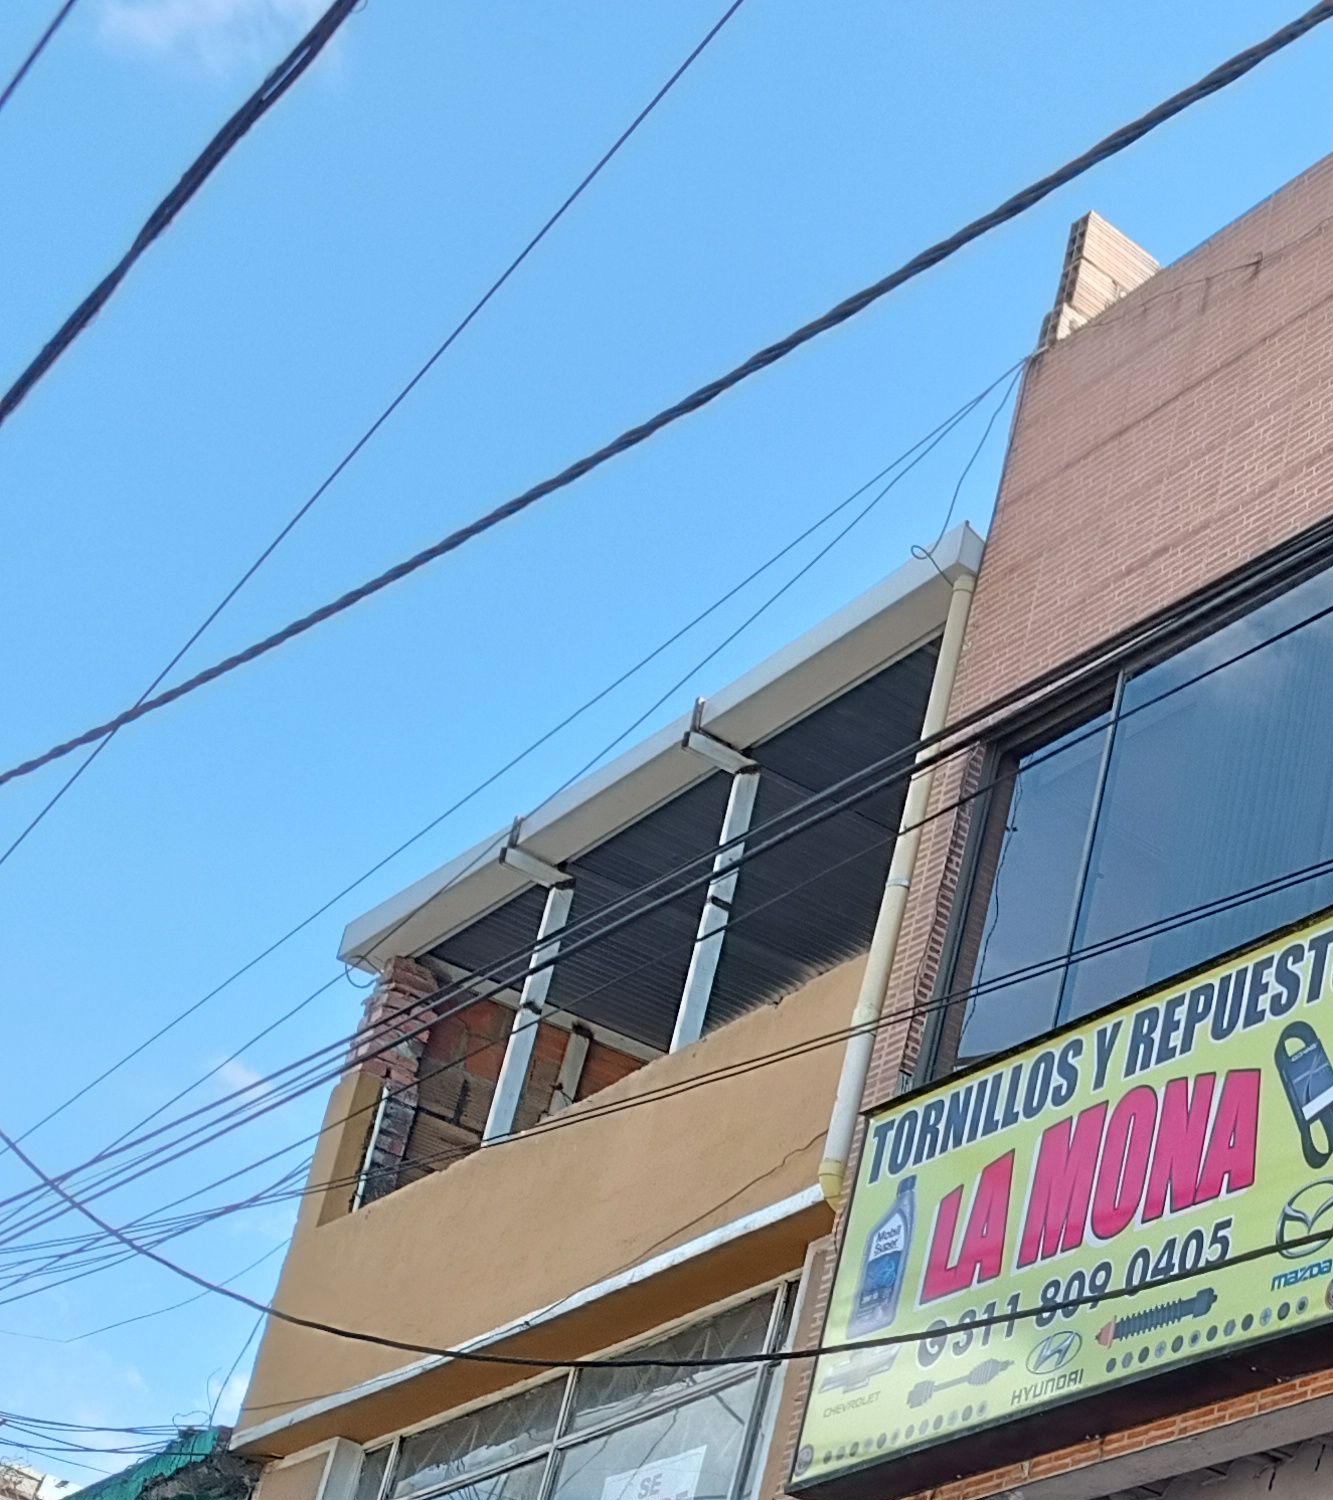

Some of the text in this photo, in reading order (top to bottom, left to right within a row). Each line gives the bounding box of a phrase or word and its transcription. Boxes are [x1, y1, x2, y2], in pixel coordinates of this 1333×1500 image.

[868, 1039, 1084, 1185] TORNILLOS
[1092, 1020, 1123, 1091] Y
[918, 1068, 1262, 1305] LA MONA
[876, 1224, 902, 1245] Mobil
[952, 1292, 1021, 1357] 311
[1035, 1261, 1113, 1328] 809
[1126, 1218, 1233, 1284] 0405
[822, 1390, 881, 1419] CHEVROLET
[1010, 1368, 1084, 1406] HYUNDAI
[637, 1472, 664, 1499] SE
